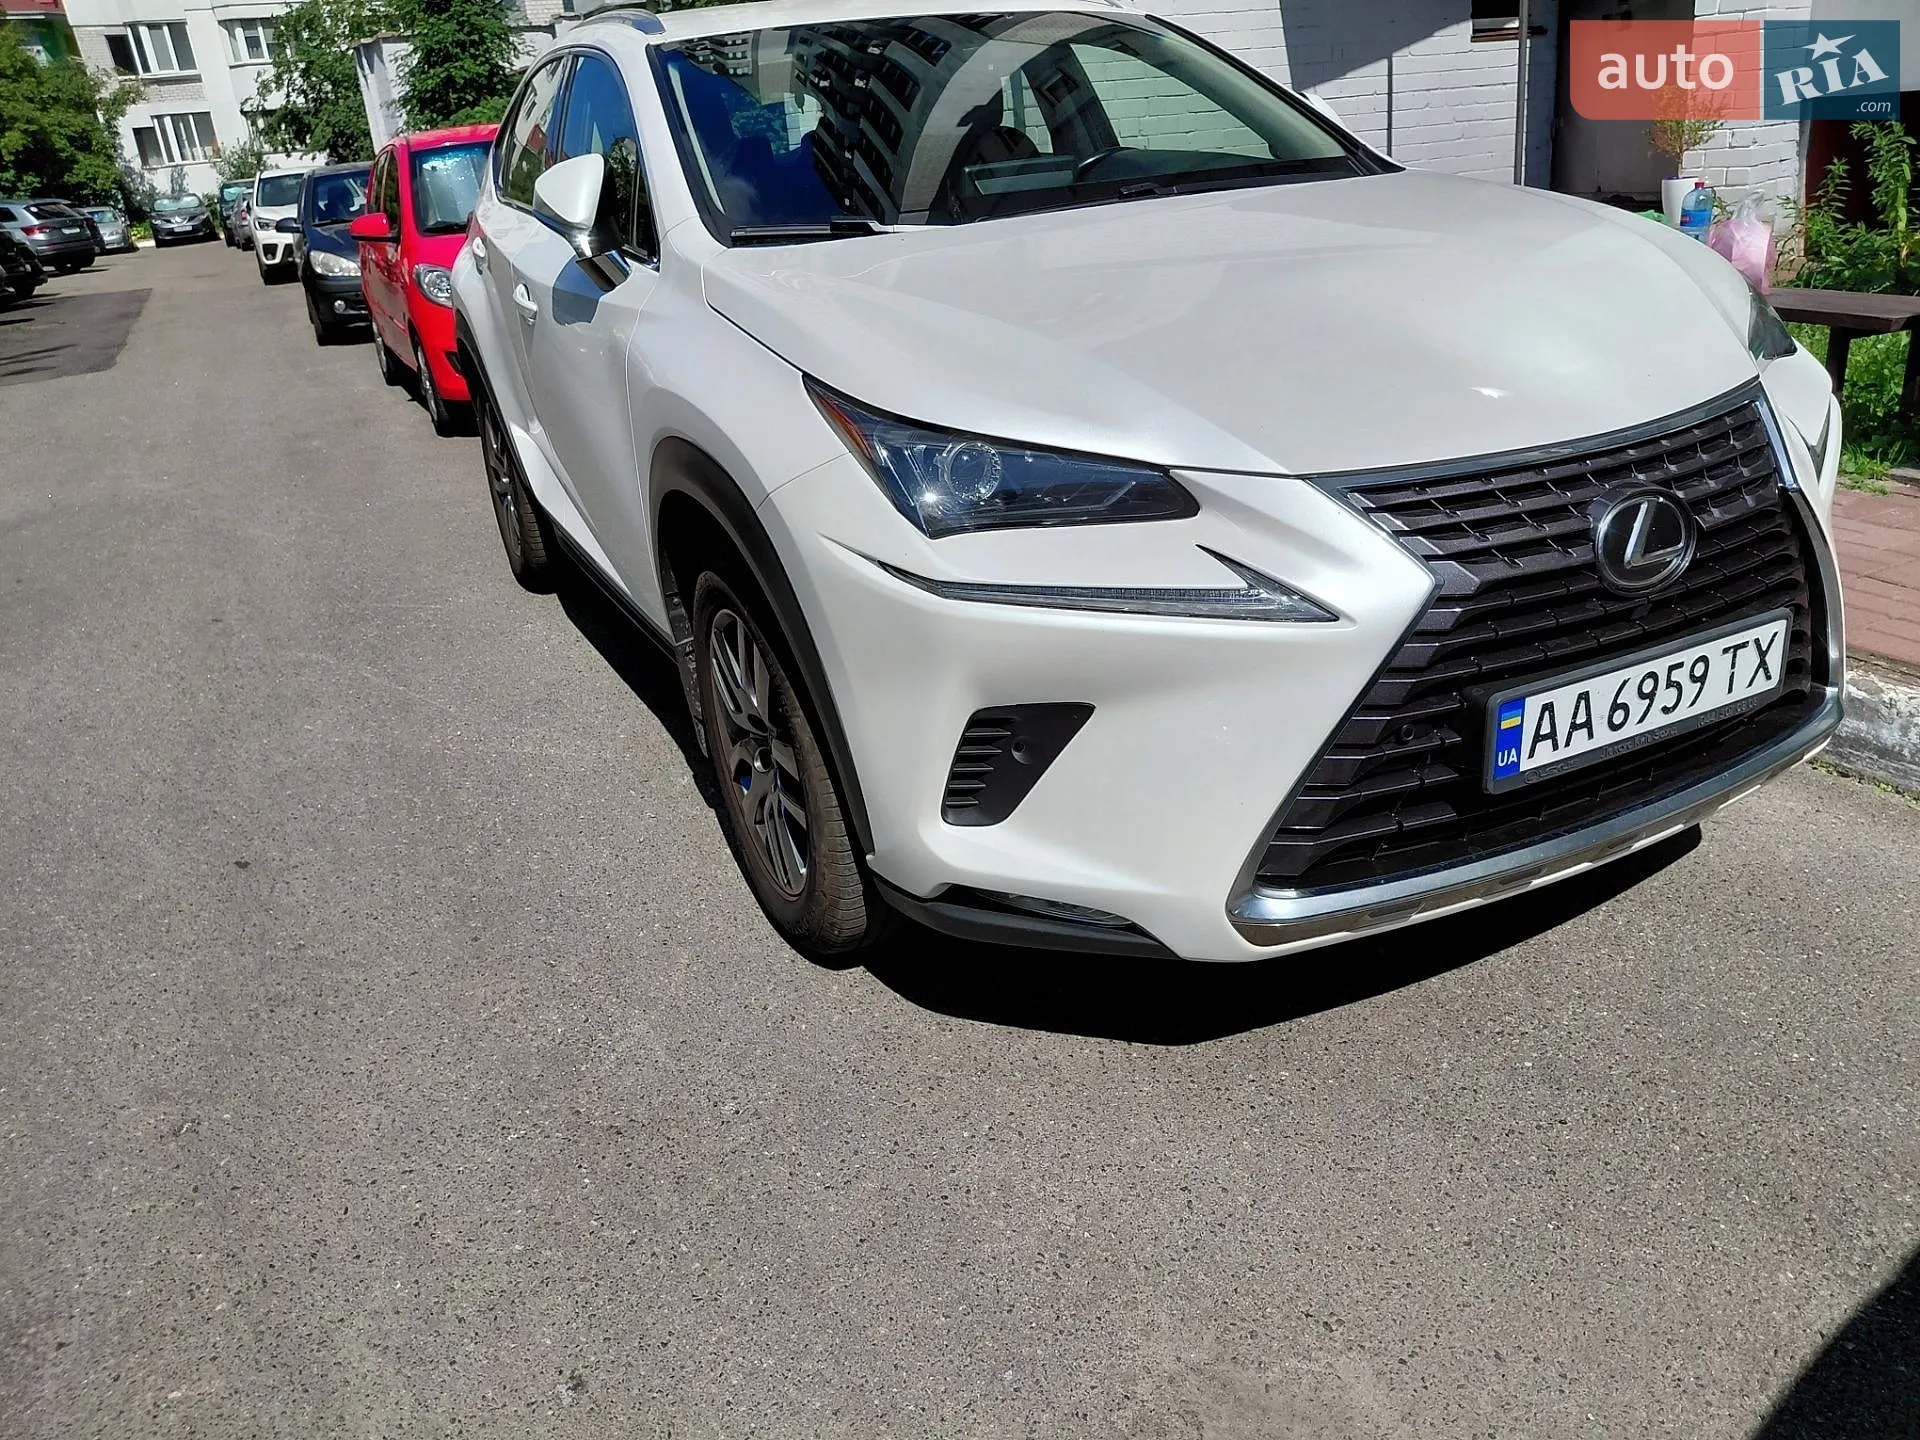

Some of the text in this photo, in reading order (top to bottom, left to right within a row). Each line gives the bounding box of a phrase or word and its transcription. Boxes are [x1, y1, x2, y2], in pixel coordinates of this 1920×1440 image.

[1527, 690, 1595, 760] AA
[1607, 655, 1710, 732] 6959
[1722, 631, 1779, 695] TX
[1498, 747, 1518, 767] UA
